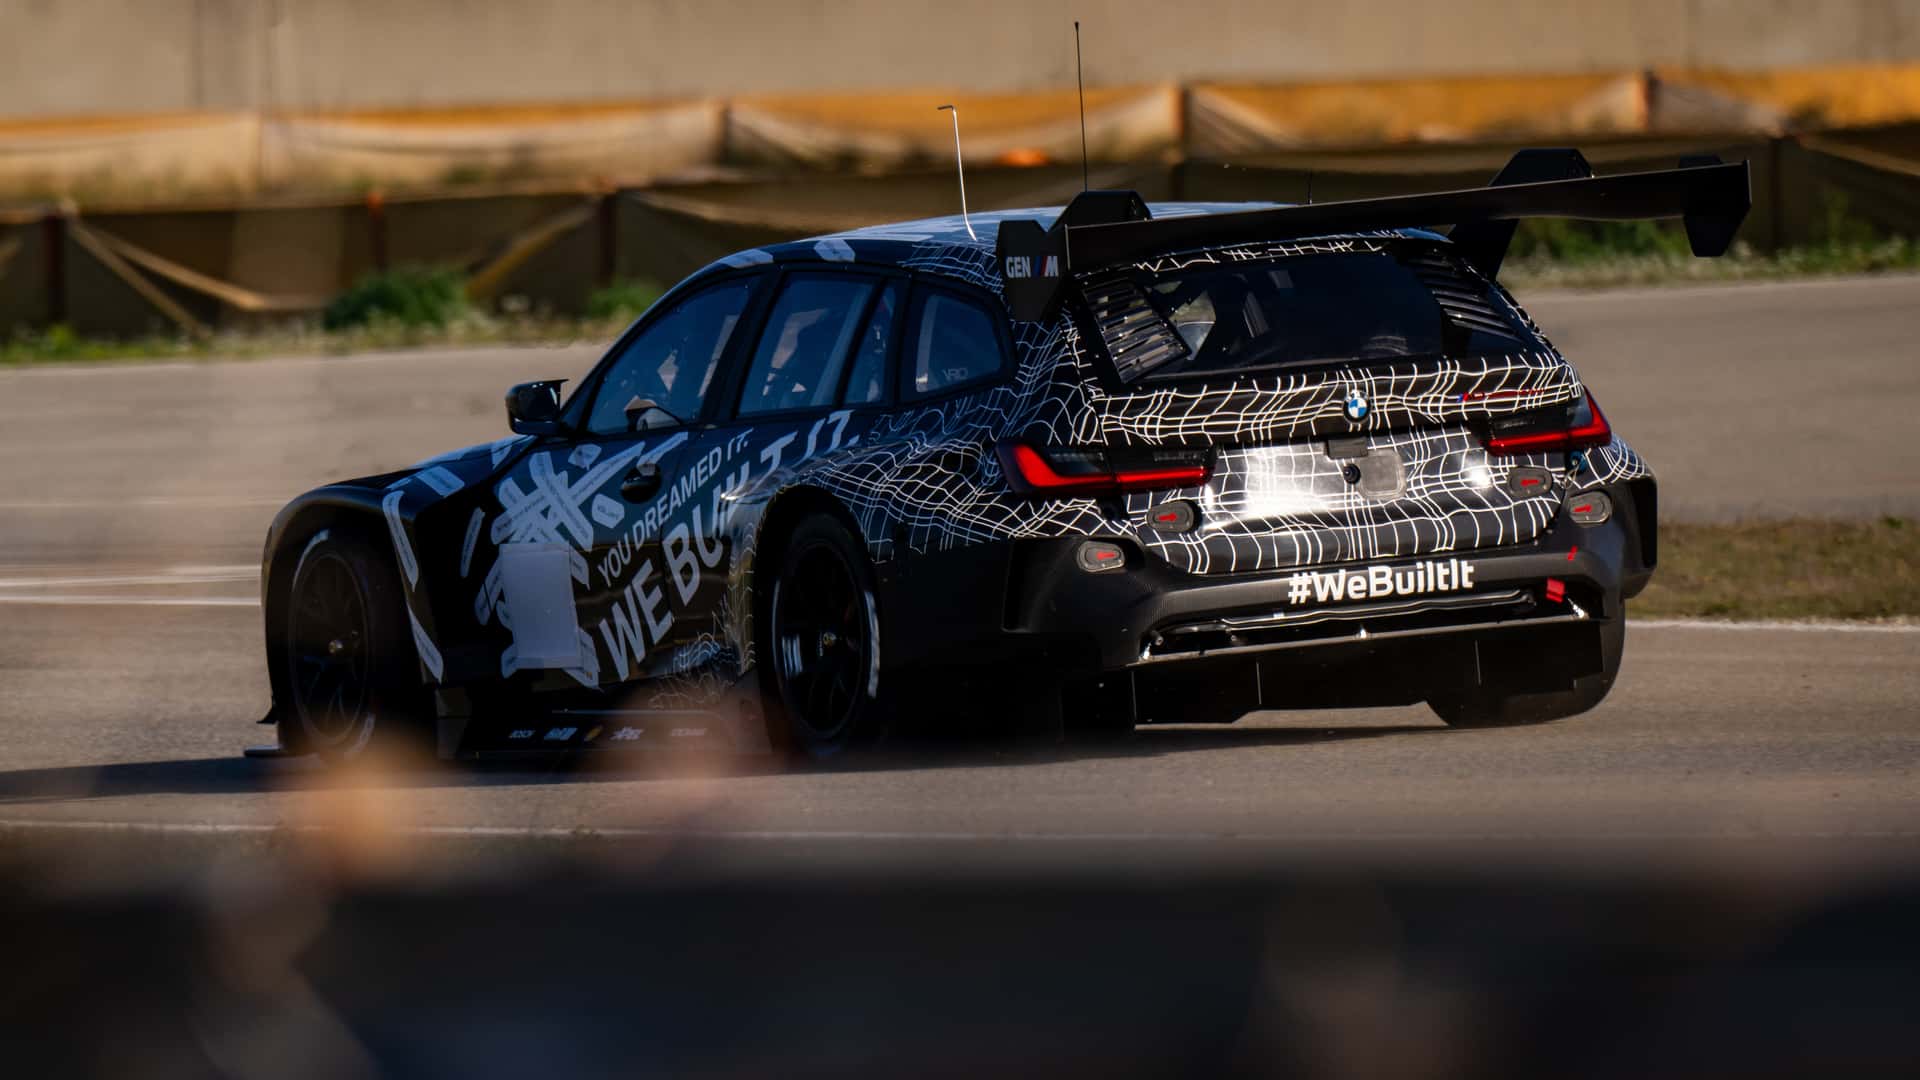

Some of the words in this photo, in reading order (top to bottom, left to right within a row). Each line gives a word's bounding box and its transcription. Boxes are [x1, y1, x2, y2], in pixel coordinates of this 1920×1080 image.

[1006, 255, 1031, 278] GEN
[598, 530, 632, 587] YOU
[632, 446, 721, 552] DREAMED
[600, 560, 674, 682] WE
[1288, 559, 1474, 604] #WeBuiltIt
